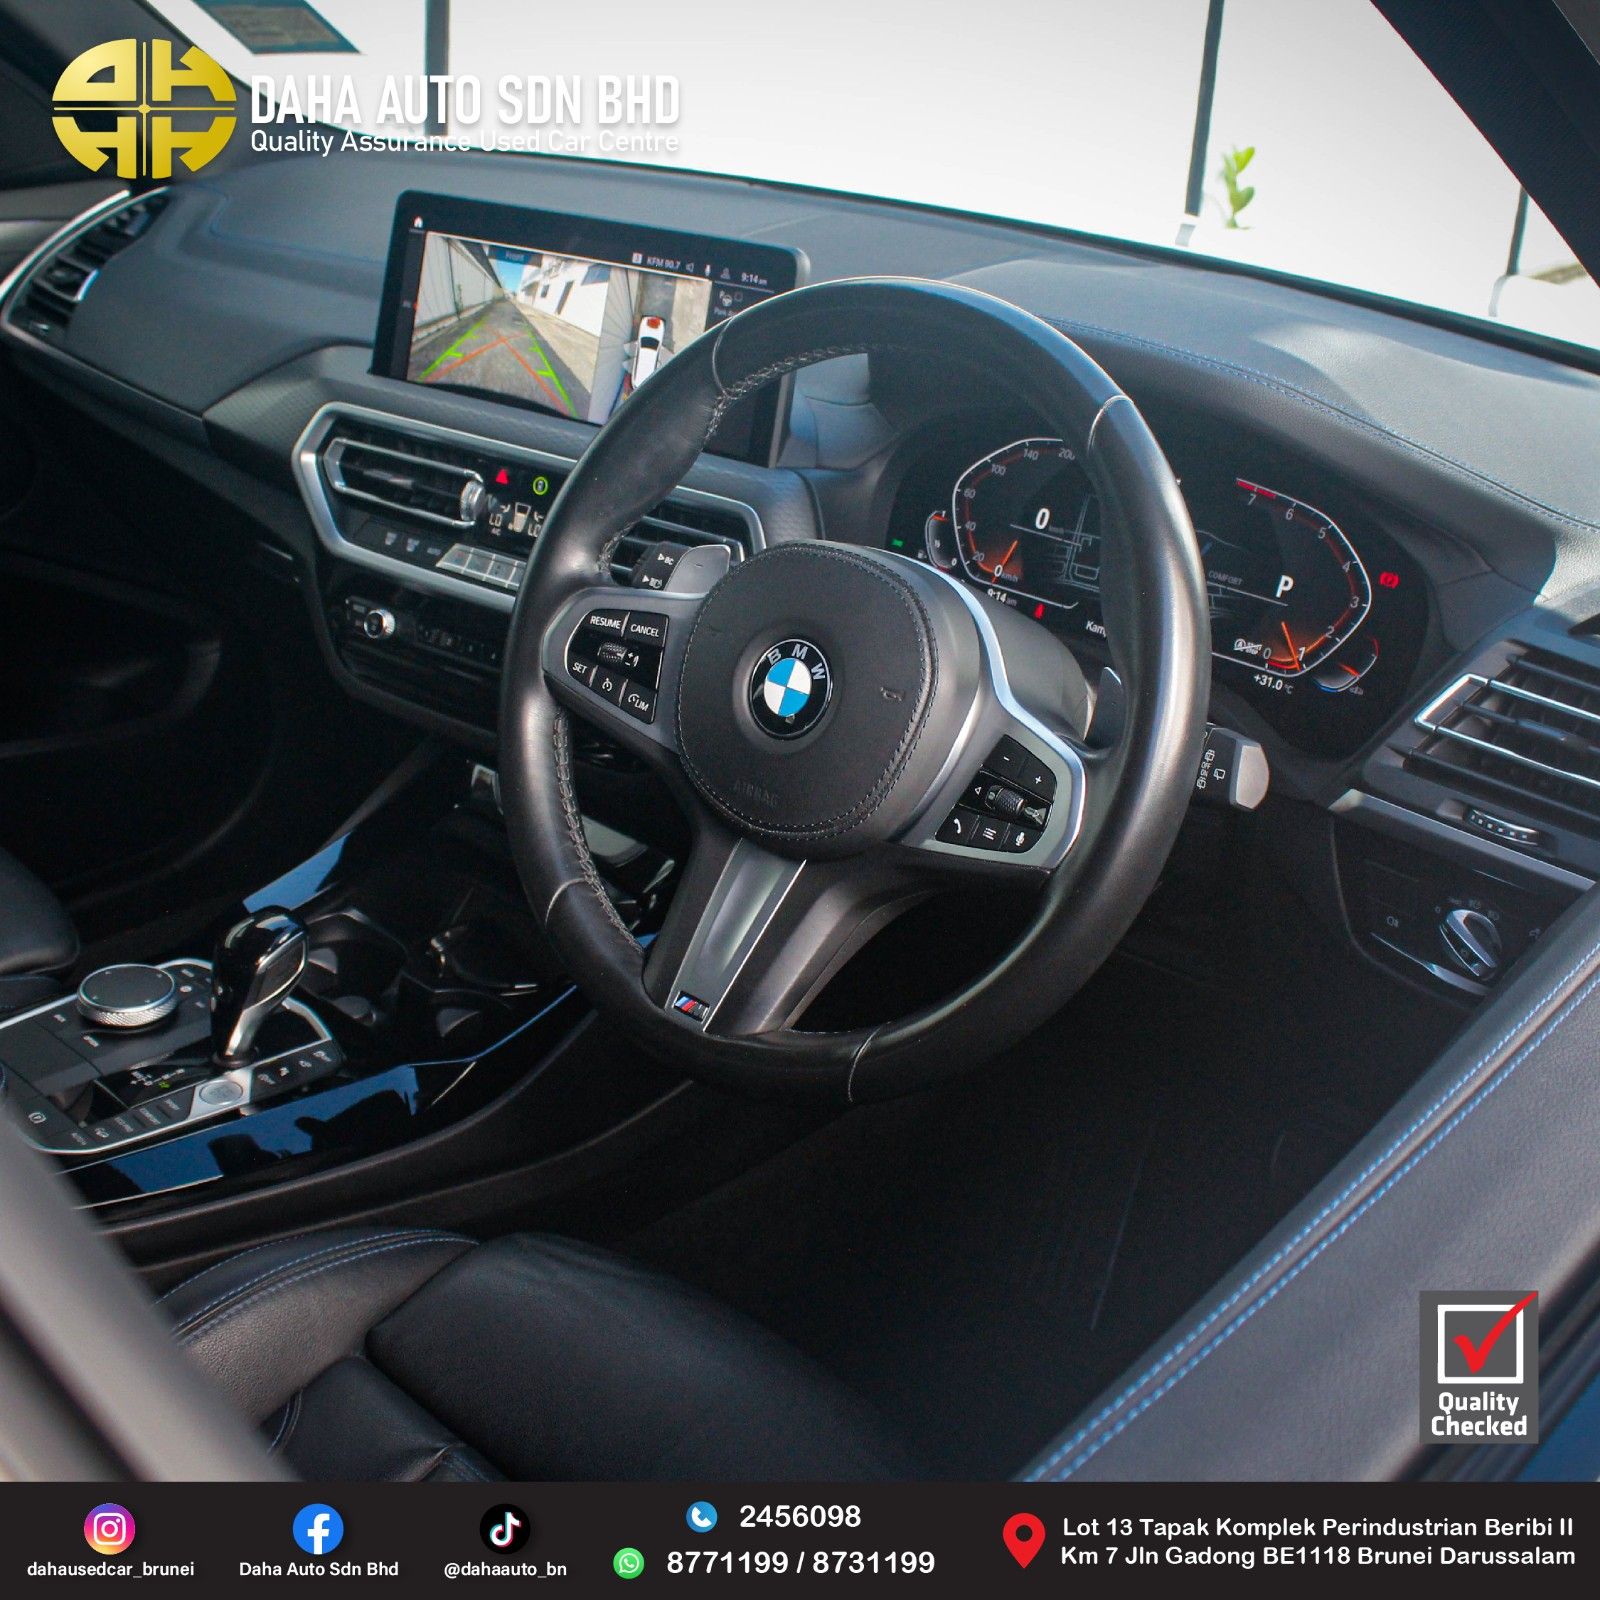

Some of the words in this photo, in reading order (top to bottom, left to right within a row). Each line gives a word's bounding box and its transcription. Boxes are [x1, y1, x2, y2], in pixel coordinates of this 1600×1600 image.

[1247, 493, 1257, 506] 7
[1035, 507, 1050, 530] 0
[1285, 508, 1294, 521] 6
[1317, 527, 1327, 539] 5
[1342, 560, 1351, 574] 4
[1275, 574, 1294, 598] P
[1350, 596, 1359, 608] 3
[589, 615, 621, 630] RESUME
[630, 623, 660, 638] CANCEL
[1325, 625, 1335, 638] 2
[1263, 647, 1272, 660] 0
[572, 662, 587, 675] SET
[766, 643, 826, 681] BMW
[634, 698, 650, 712] LIM
